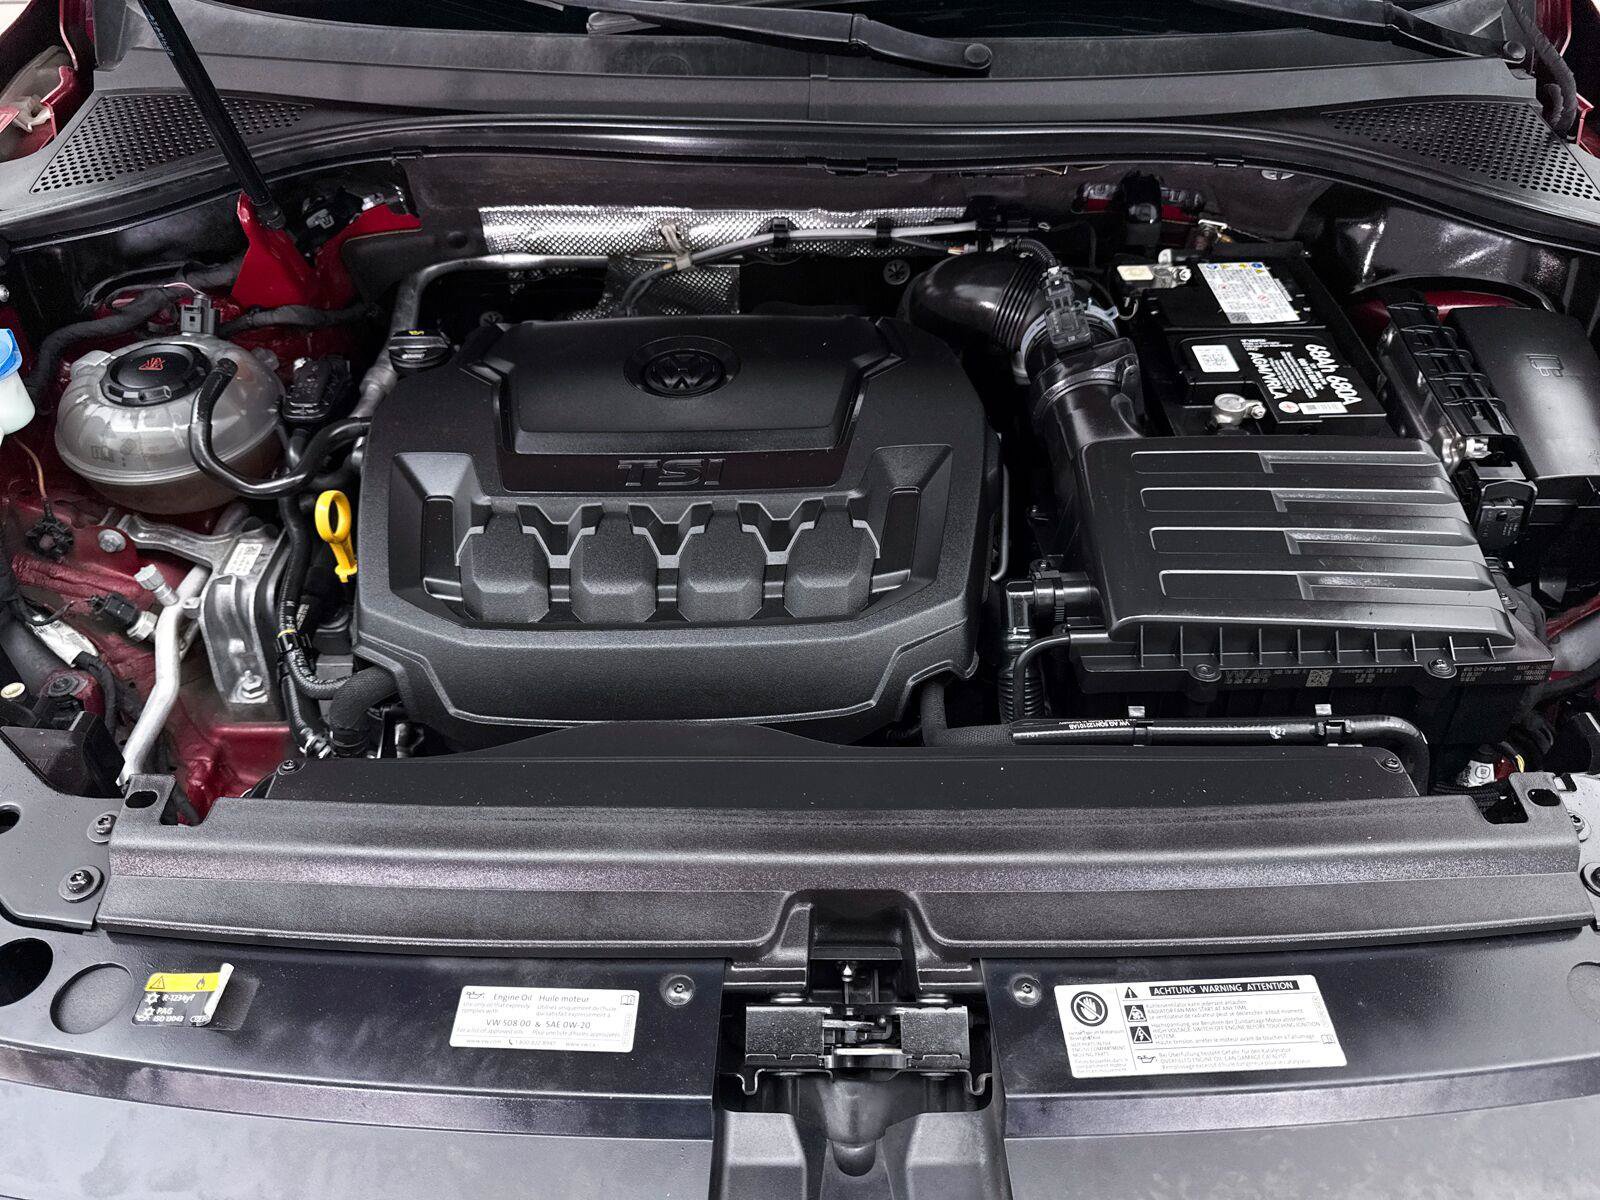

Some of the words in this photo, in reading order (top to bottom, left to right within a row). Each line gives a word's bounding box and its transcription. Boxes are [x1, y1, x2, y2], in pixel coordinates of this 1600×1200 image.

[1248, 352, 1288, 399] AGM/VRLA
[1305, 344, 1339, 373] 68Ah
[1326, 375, 1362, 406] 680A
[618, 458, 726, 486] TSI
[1154, 986, 1196, 995] ACHTUNG
[1200, 984, 1242, 993] WARNING
[1247, 982, 1294, 991] ATTENTION
[493, 994, 519, 1002] Engine
[156, 1007, 174, 1015] PAG
[487, 1019, 501, 1027] VW
[503, 1019, 518, 1027] 508
[520, 1019, 531, 1027] 00
[546, 1020, 560, 1028] SAE
[563, 1020, 591, 1029] 0W-20
